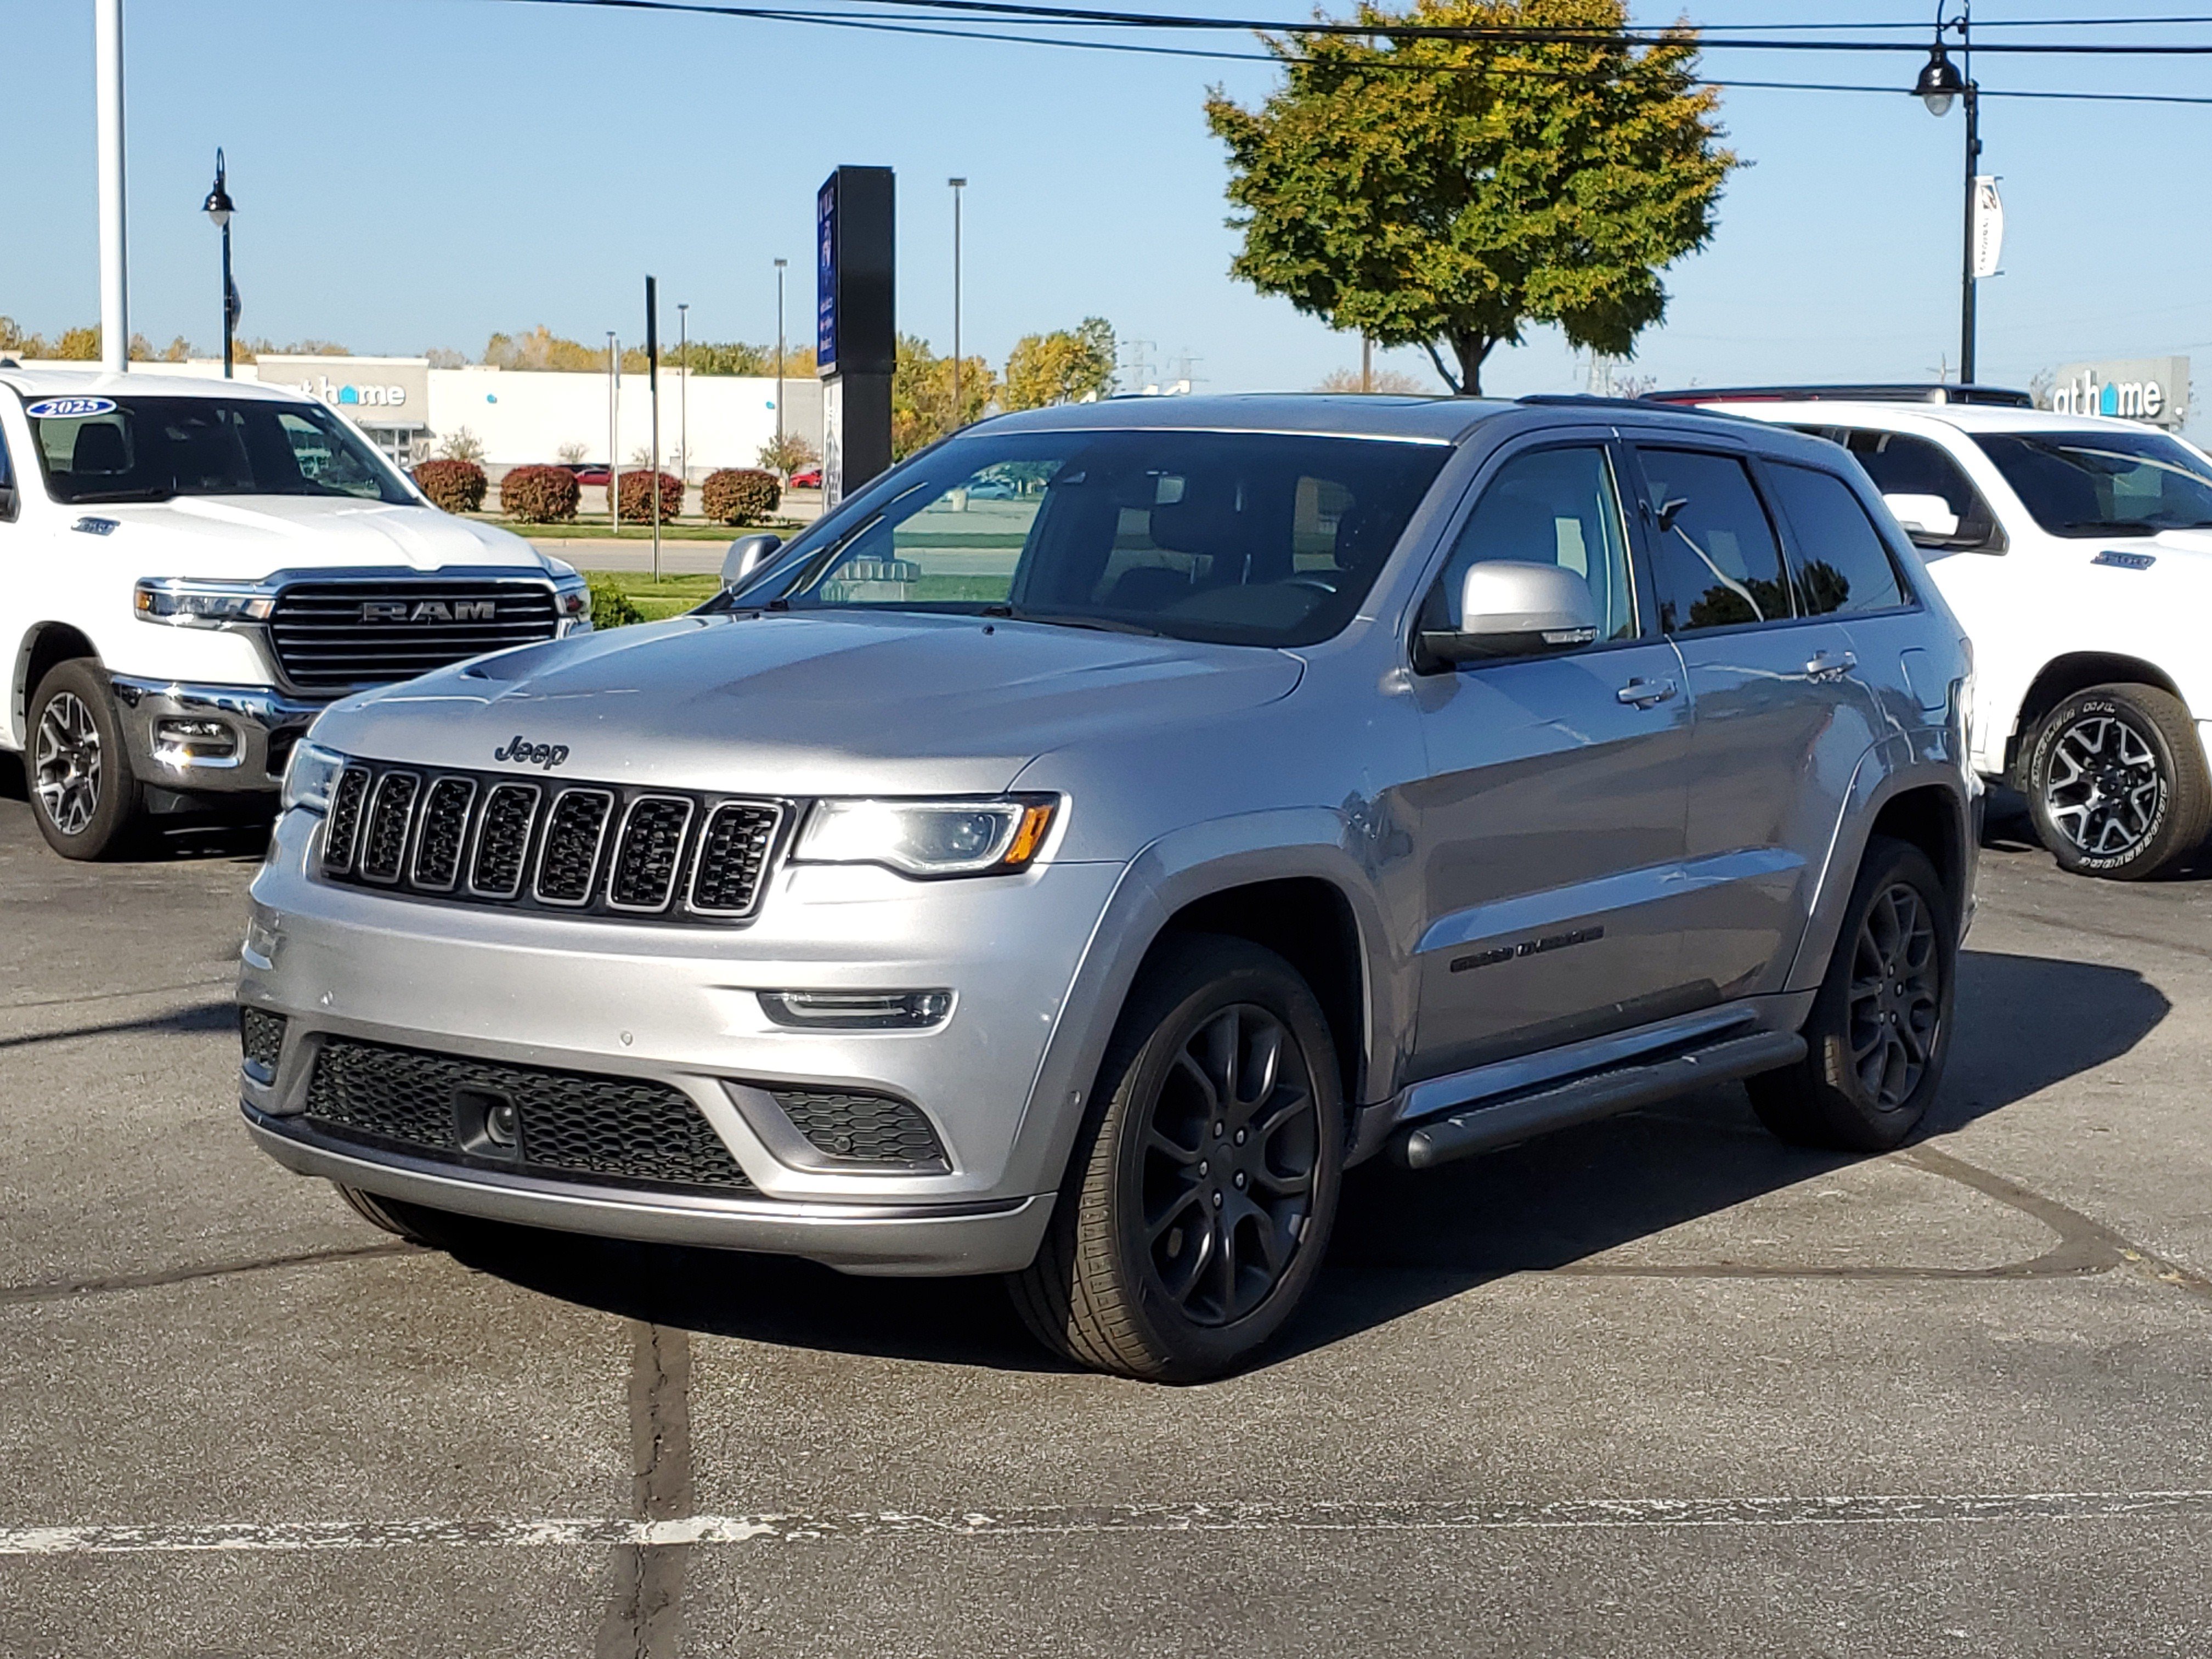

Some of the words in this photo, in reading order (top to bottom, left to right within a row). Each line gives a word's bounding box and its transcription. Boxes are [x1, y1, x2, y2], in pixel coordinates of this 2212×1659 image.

[44, 400, 99, 416] 2025
[2053, 378, 2083, 416] at
[361, 601, 495, 622] RAM
[494, 735, 570, 771] Jeep
